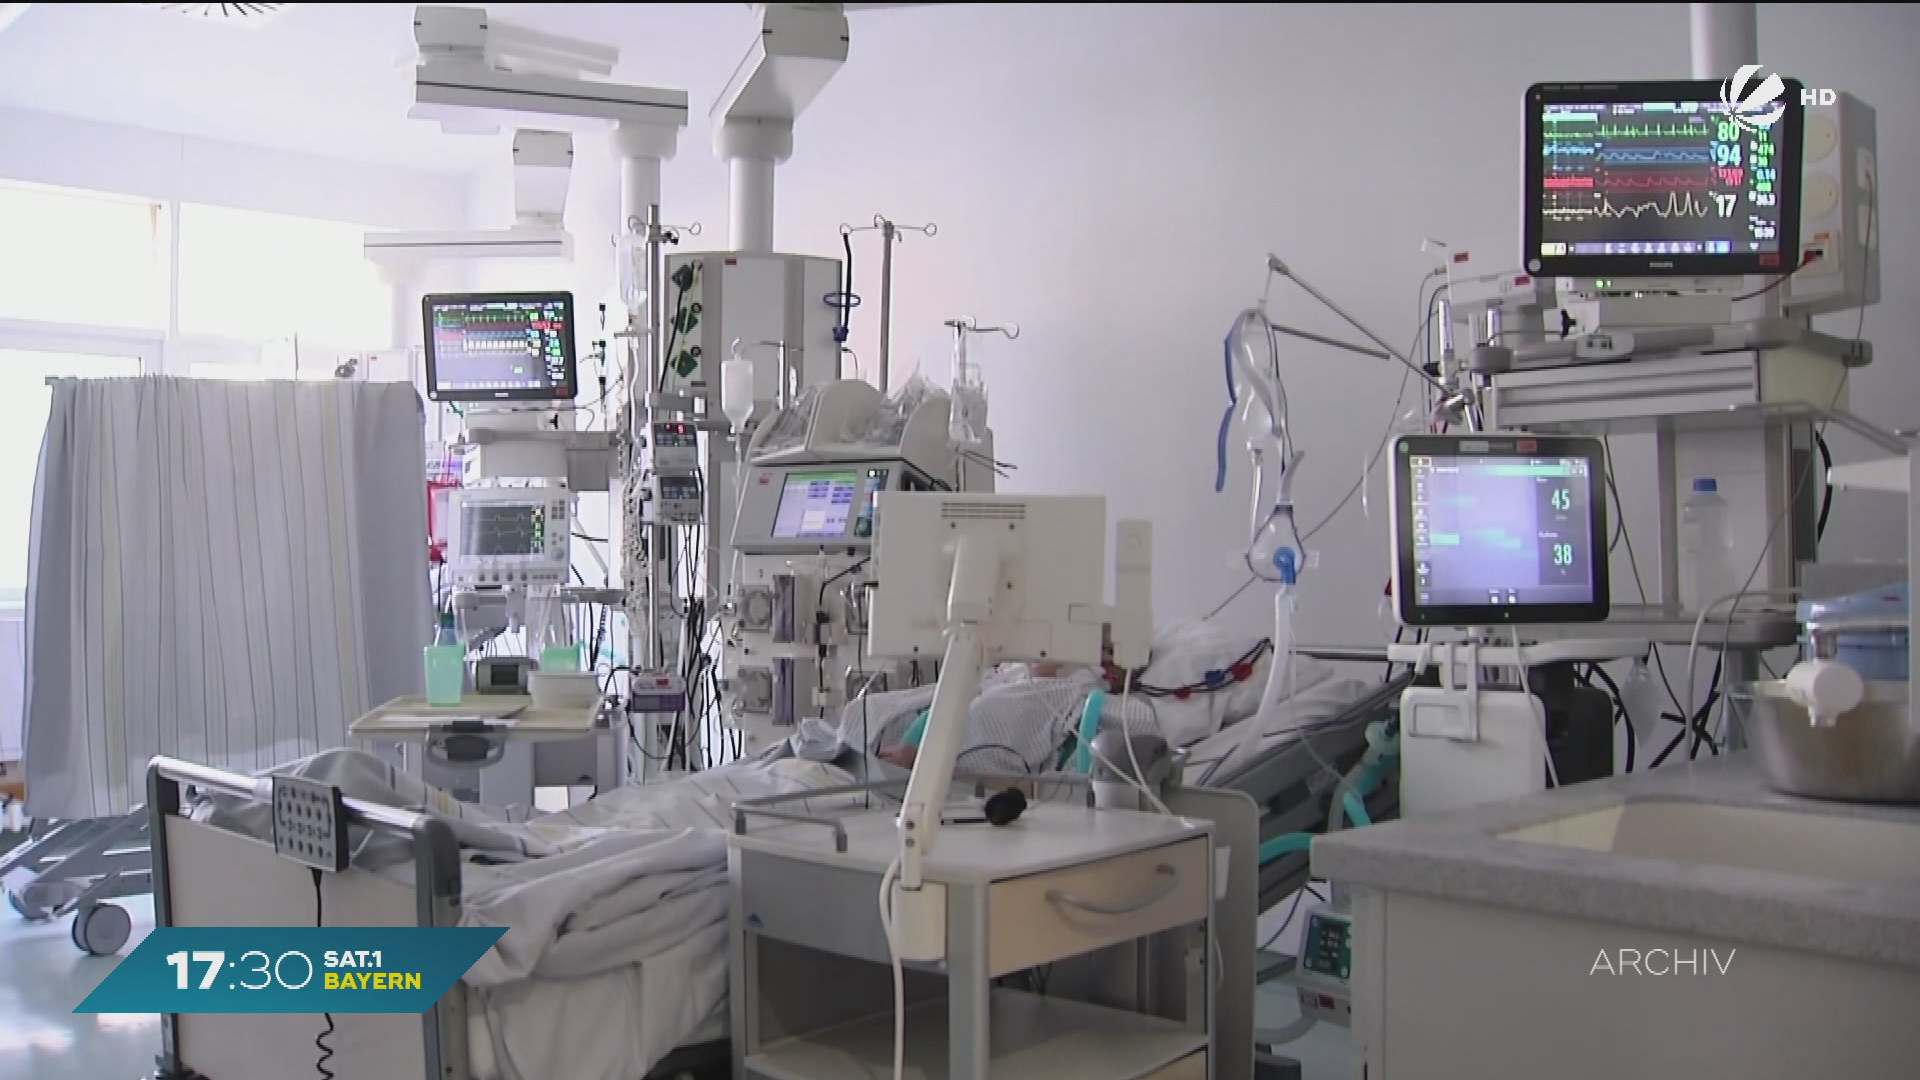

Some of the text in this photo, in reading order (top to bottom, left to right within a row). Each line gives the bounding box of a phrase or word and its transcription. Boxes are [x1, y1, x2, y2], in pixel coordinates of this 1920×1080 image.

[1718, 121, 1739, 141] 80
[1717, 144, 1741, 166] 94
[1716, 194, 1737, 217] 17
[1552, 489, 1570, 509] 45
[1554, 544, 1572, 565] 38
